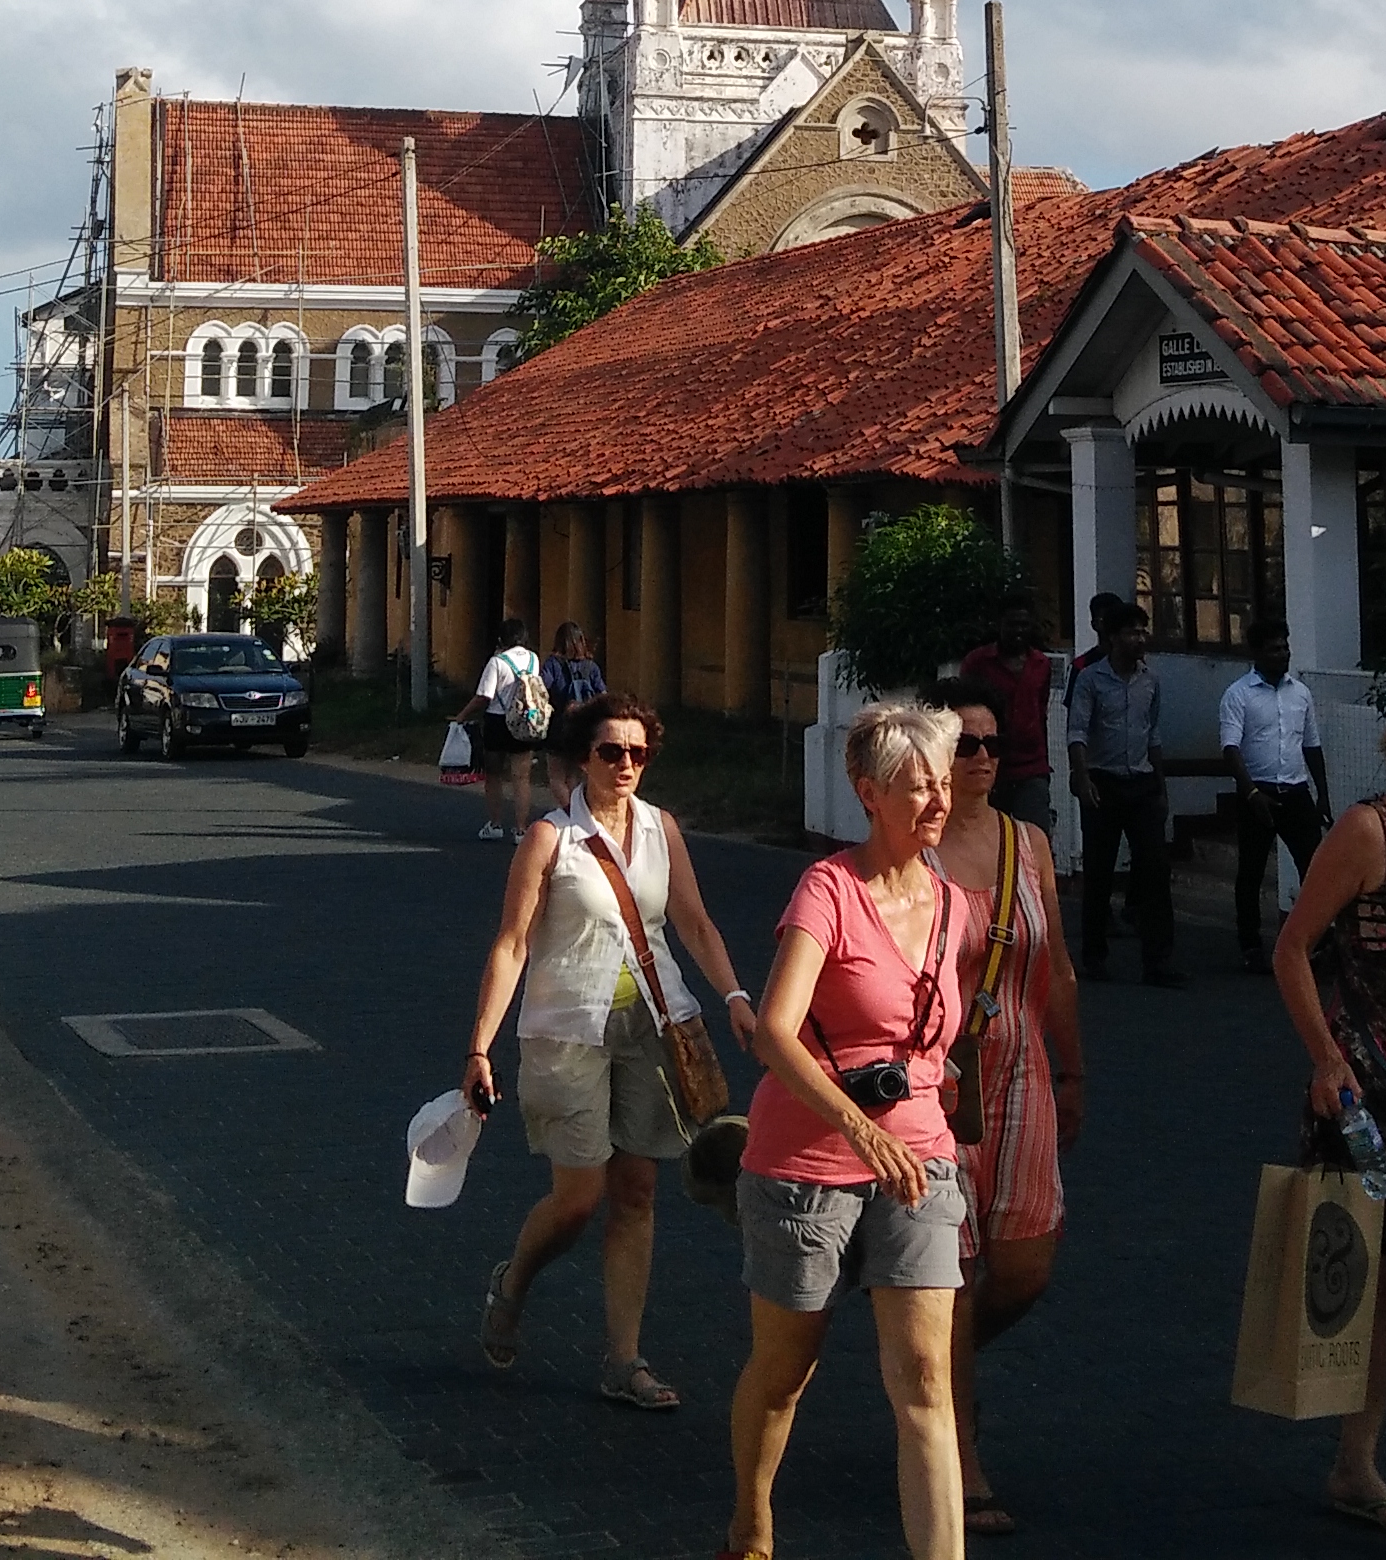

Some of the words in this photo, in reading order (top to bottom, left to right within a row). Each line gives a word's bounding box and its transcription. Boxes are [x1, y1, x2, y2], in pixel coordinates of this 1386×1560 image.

[1162, 338, 1191, 356] GALLE
[1194, 338, 1207, 353] L
[1162, 359, 1205, 377] ESTABLISHED
[1206, 358, 1213, 373] IN
[1329, 1340, 1361, 1368] ROOTS
